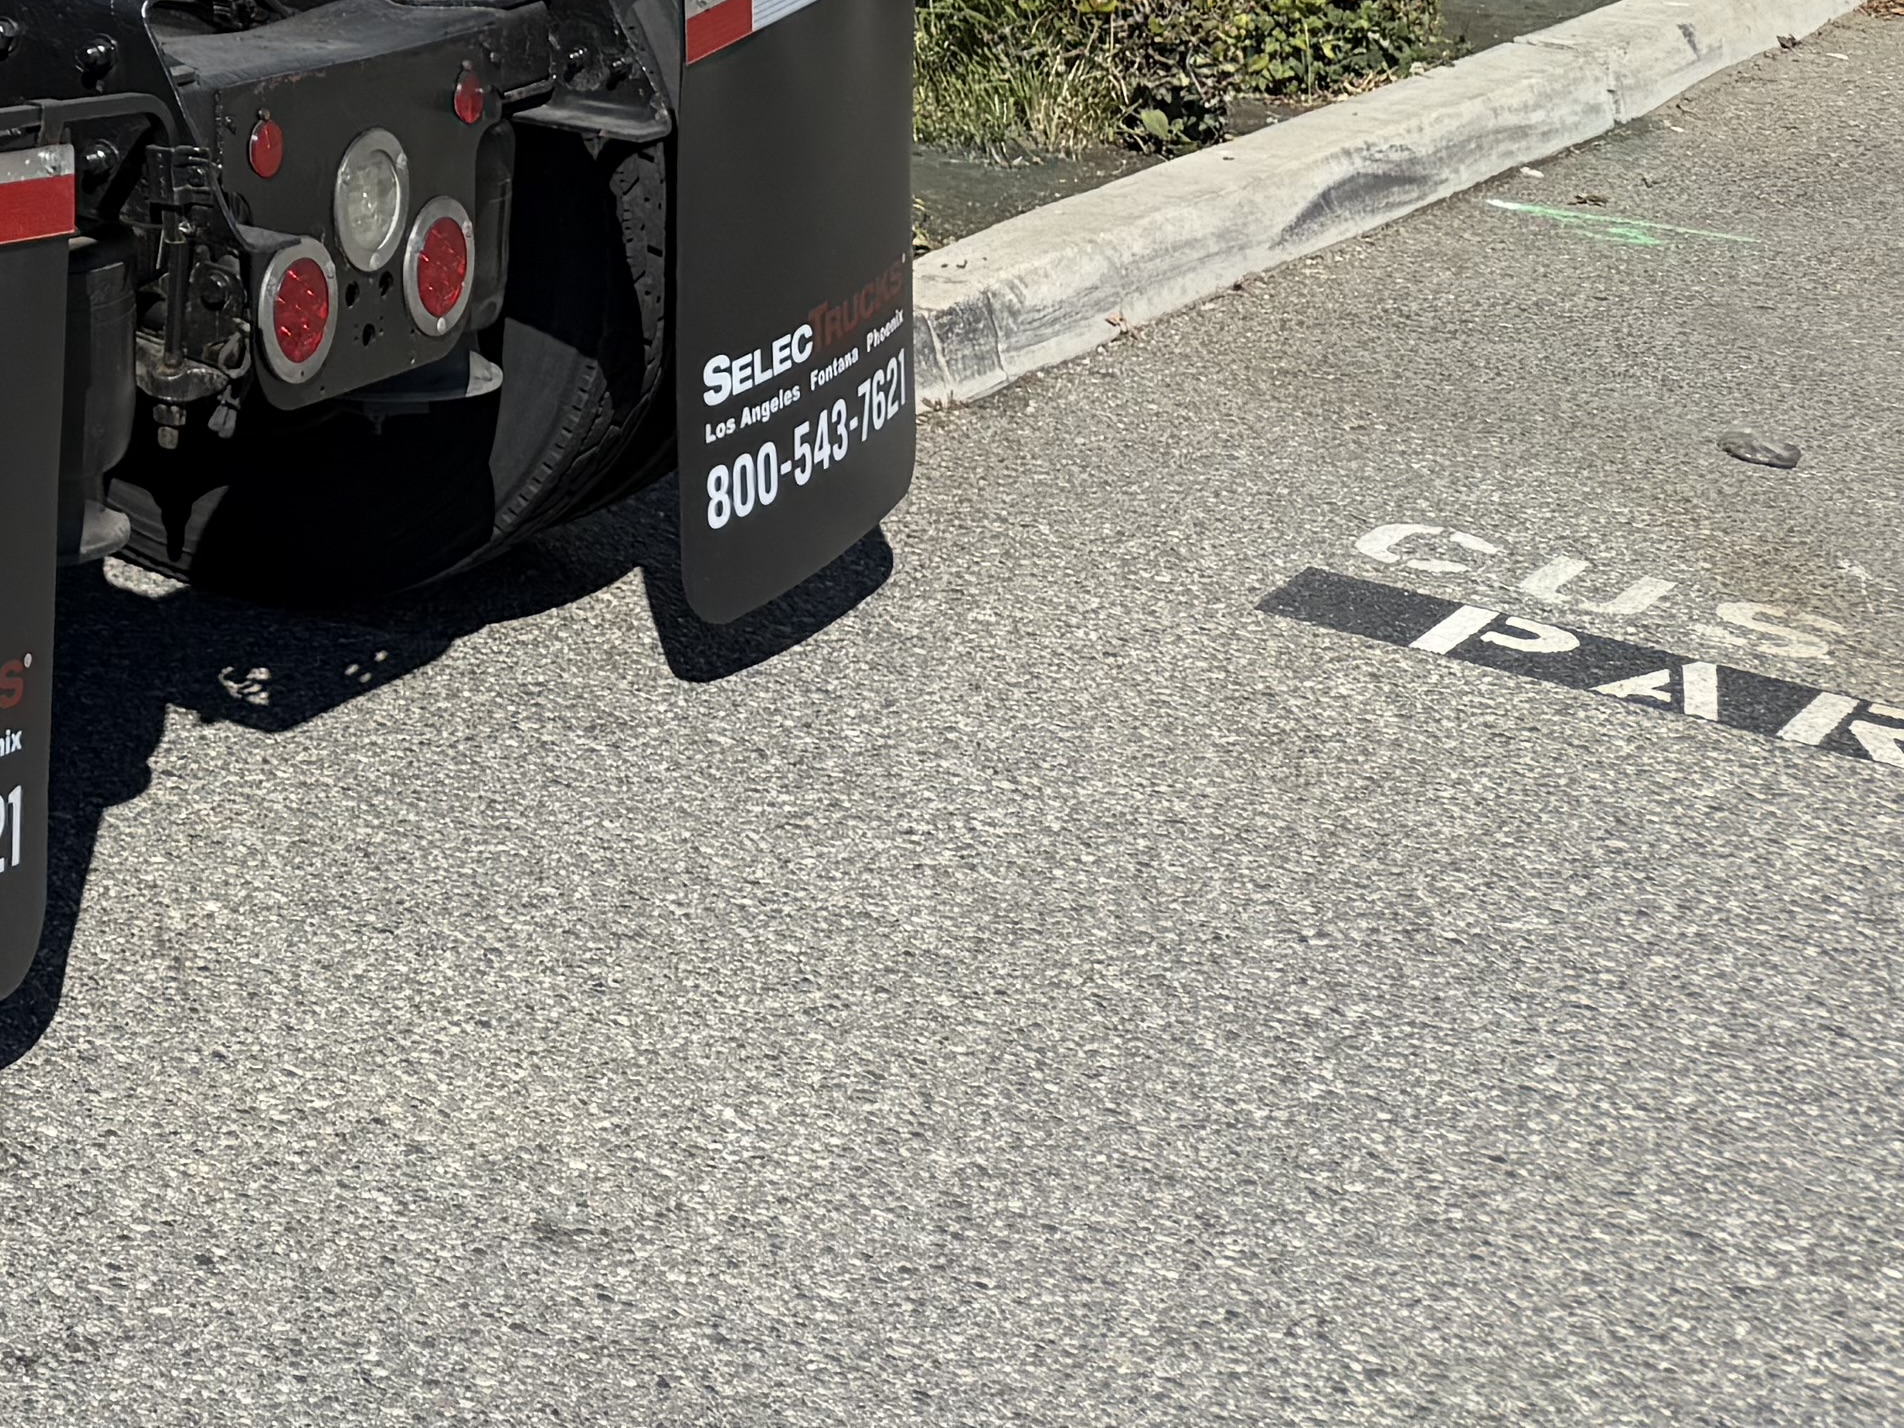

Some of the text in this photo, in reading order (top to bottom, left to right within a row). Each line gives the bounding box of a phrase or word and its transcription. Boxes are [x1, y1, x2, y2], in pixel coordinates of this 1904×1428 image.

[705, 309, 904, 444] Los Angeles Fontana Phoenix
[706, 347, 906, 530] 800-543-7621
